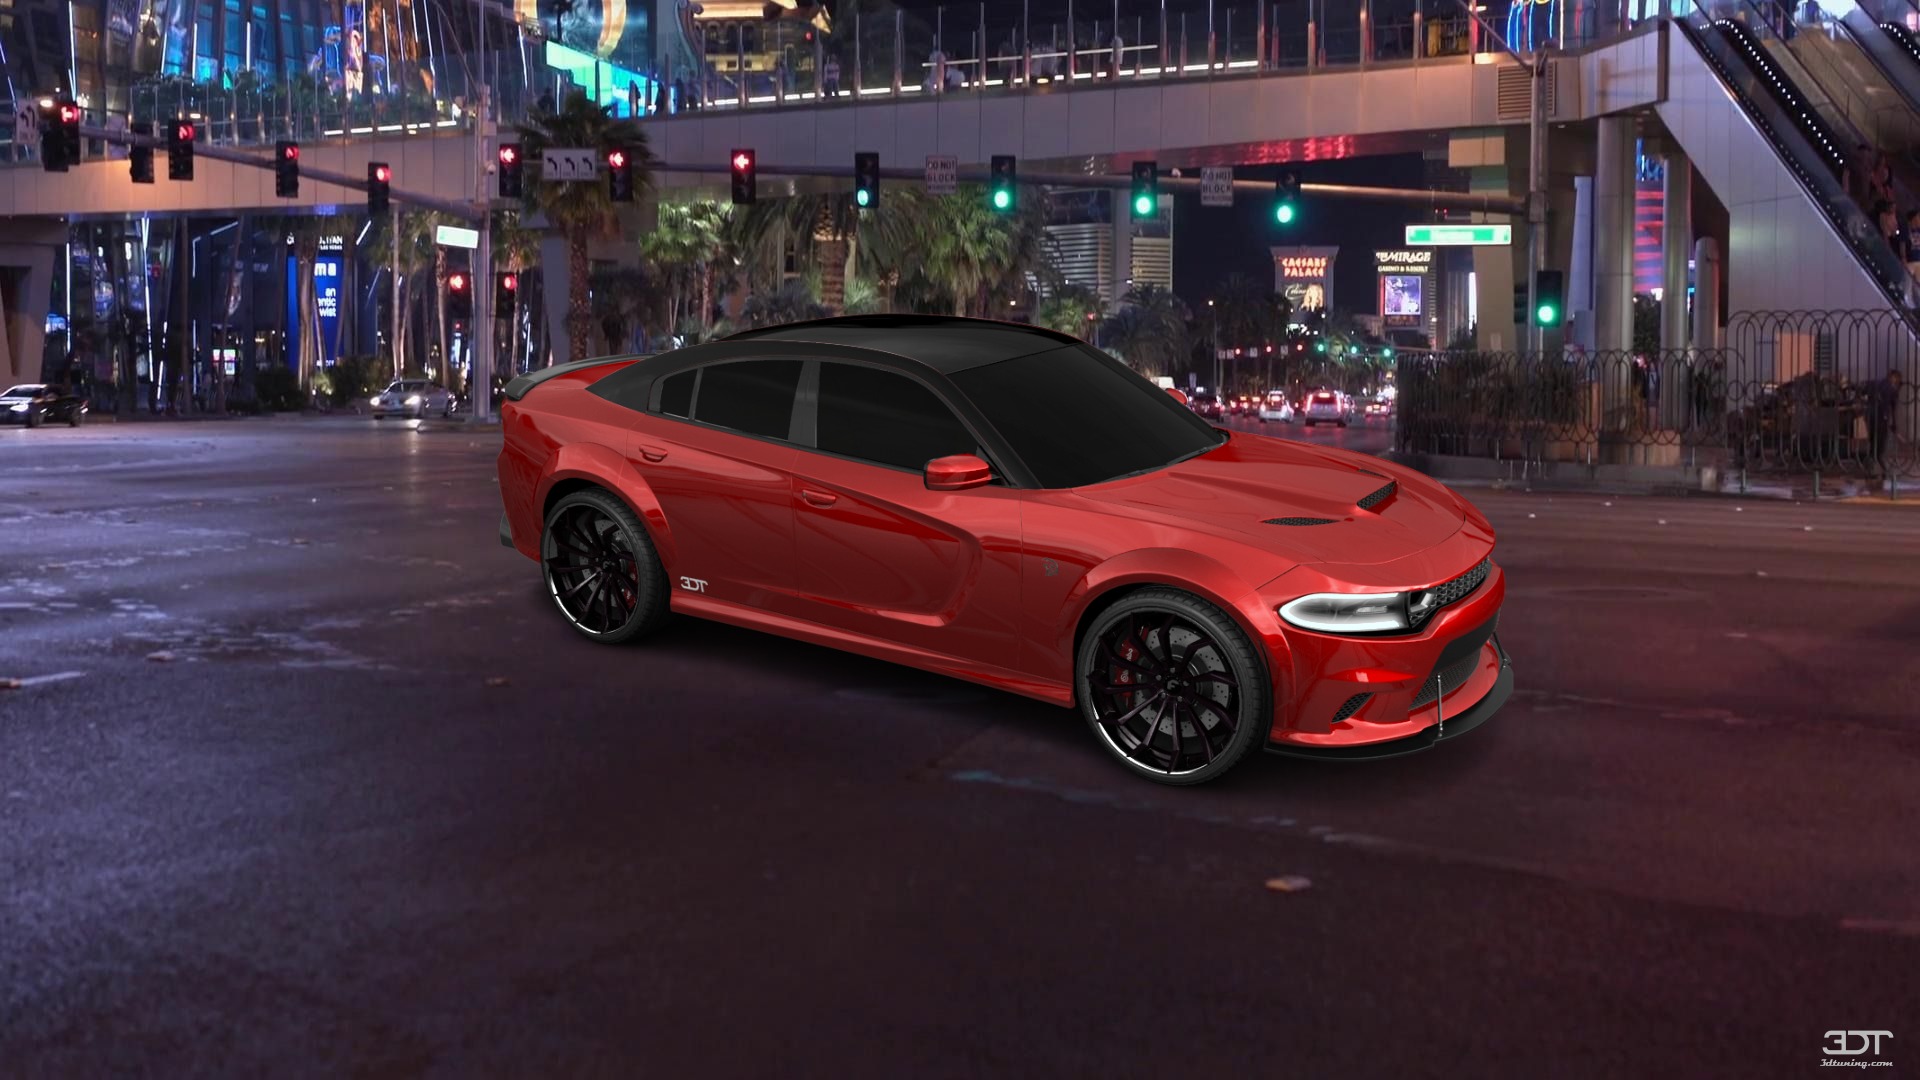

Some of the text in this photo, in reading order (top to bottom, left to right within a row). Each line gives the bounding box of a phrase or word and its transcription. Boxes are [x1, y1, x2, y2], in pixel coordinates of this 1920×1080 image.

[1281, 257, 1327, 267] CAESARS
[1284, 267, 1324, 277] PALACE
[680, 576, 709, 593] 3DT
